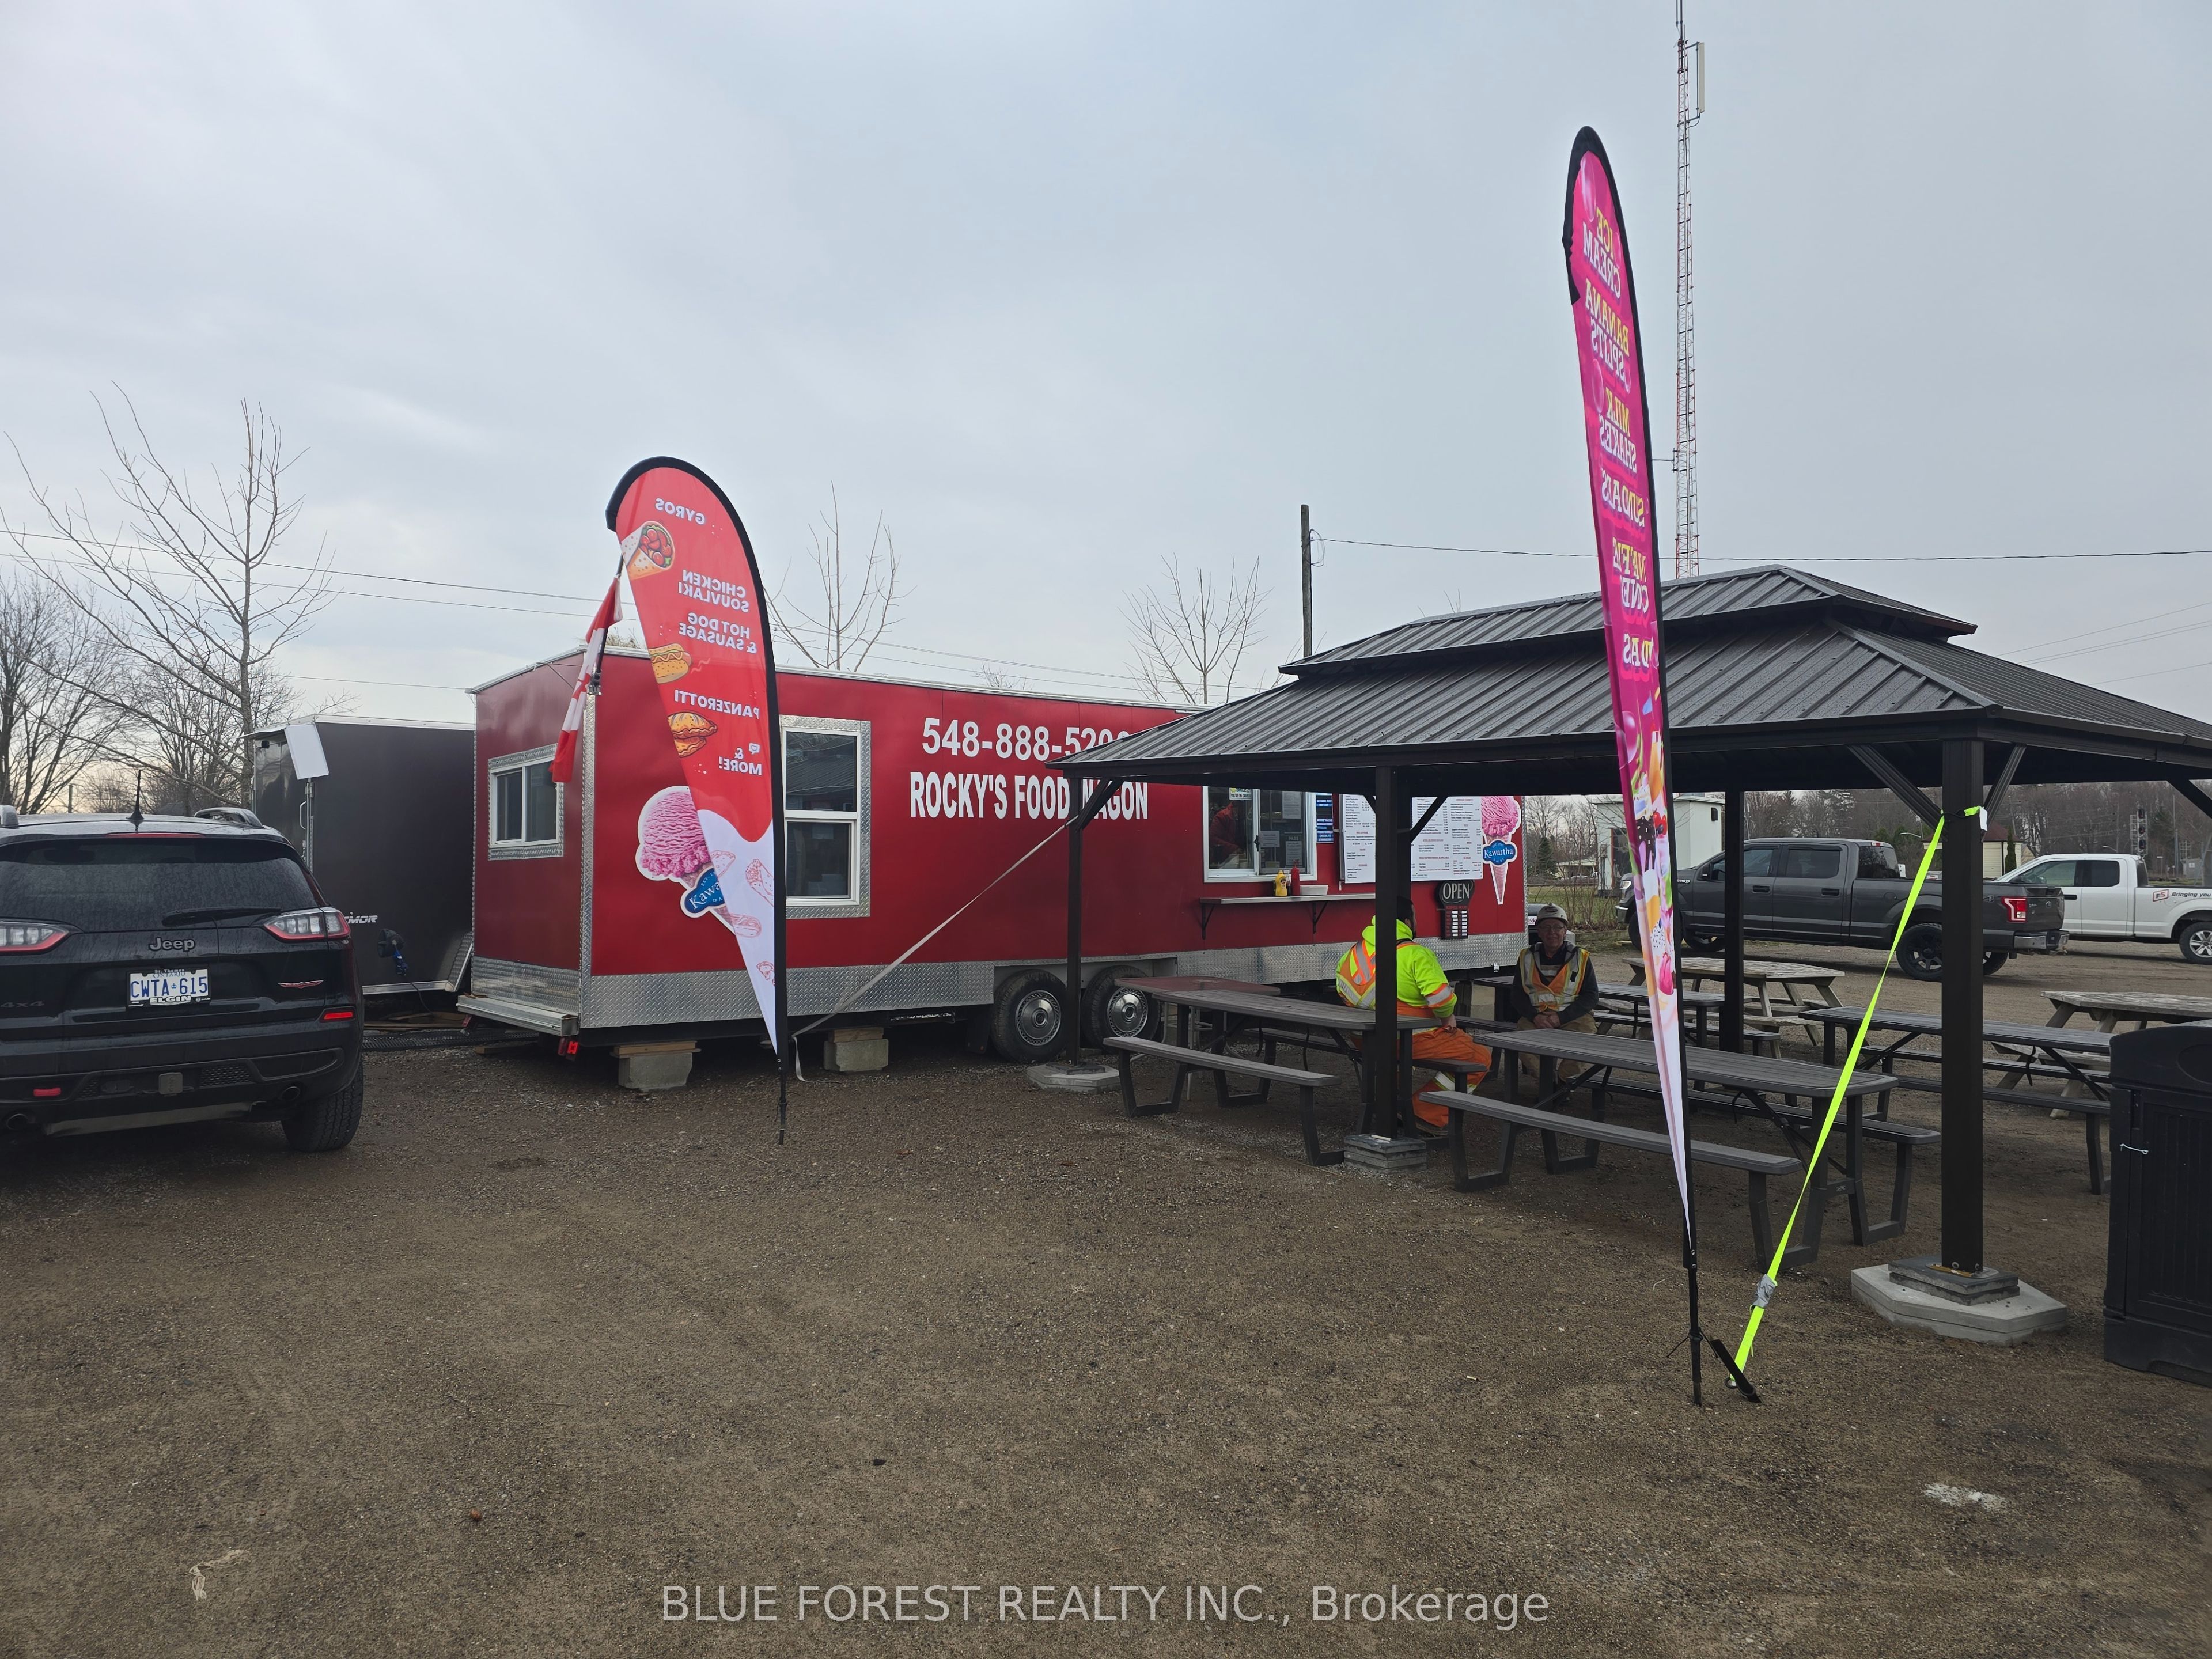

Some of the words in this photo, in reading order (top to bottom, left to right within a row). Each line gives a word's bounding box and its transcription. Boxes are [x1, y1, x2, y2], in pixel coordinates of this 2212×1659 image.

[922, 717, 1130, 762] 548-888-52
[910, 772, 1007, 819] ROCKY'S
[1014, 775, 1070, 820] FOOD
[1484, 847, 1513, 858] Kawartha
[1442, 883, 1470, 899] OPEN
[149, 938, 195, 952] Jeep
[131, 979, 170, 998] CWTA
[180, 976, 207, 994] 615
[150, 995, 191, 1003] ELGIN
